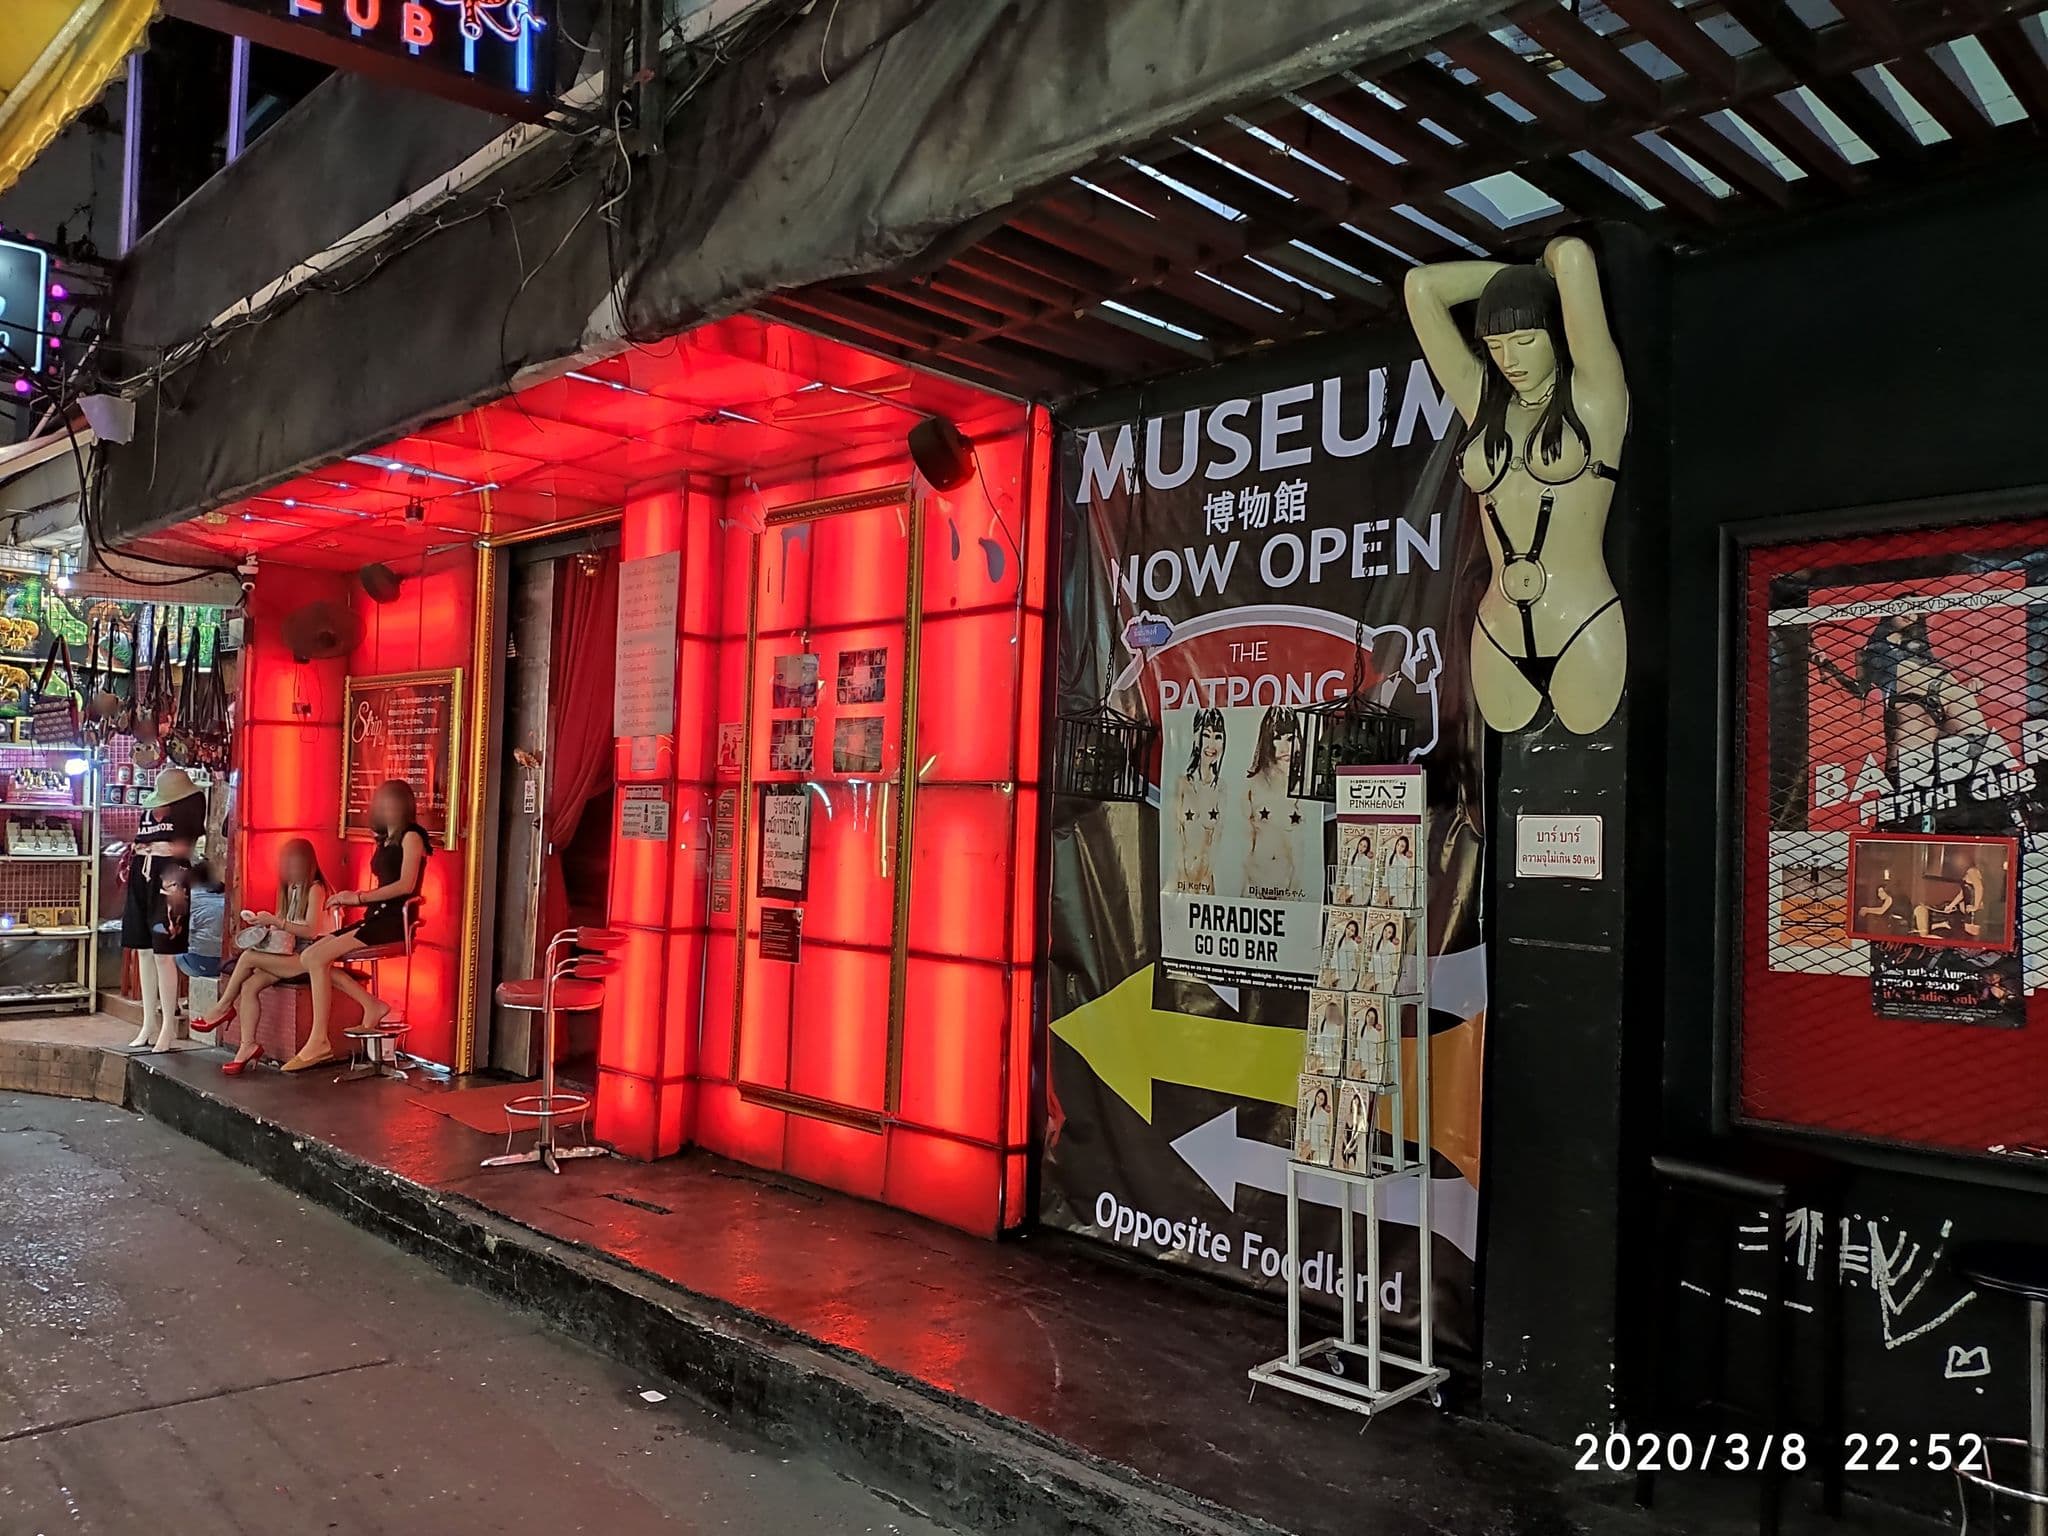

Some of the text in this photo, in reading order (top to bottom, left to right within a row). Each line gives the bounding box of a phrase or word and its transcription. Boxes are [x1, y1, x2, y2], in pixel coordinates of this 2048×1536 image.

[294, 0, 434, 46] UB
[1076, 359, 1457, 504] MUSEUM
[1203, 478, 1309, 536] 博物館
[1111, 512, 1441, 607] NOW OPEN
[1229, 641, 1269, 664] THE
[1160, 670, 1349, 712] PATPONG
[352, 701, 382, 748] Strip
[1349, 799, 1405, 809] PINKHEAVEN
[1350, 781, 1407, 799] ピンヘブ
[1536, 825, 1581, 843] บาร์ บาร์
[1522, 850, 1596, 867] ความจุไม่เกิน 50 คน
[1177, 881, 1186, 891] Dj
[1248, 886, 1259, 898] Dj
[1189, 902, 1286, 938] PARADISE
[1195, 934, 1278, 963] GO GO BAR
[1095, 1191, 1231, 1264] Opposite
